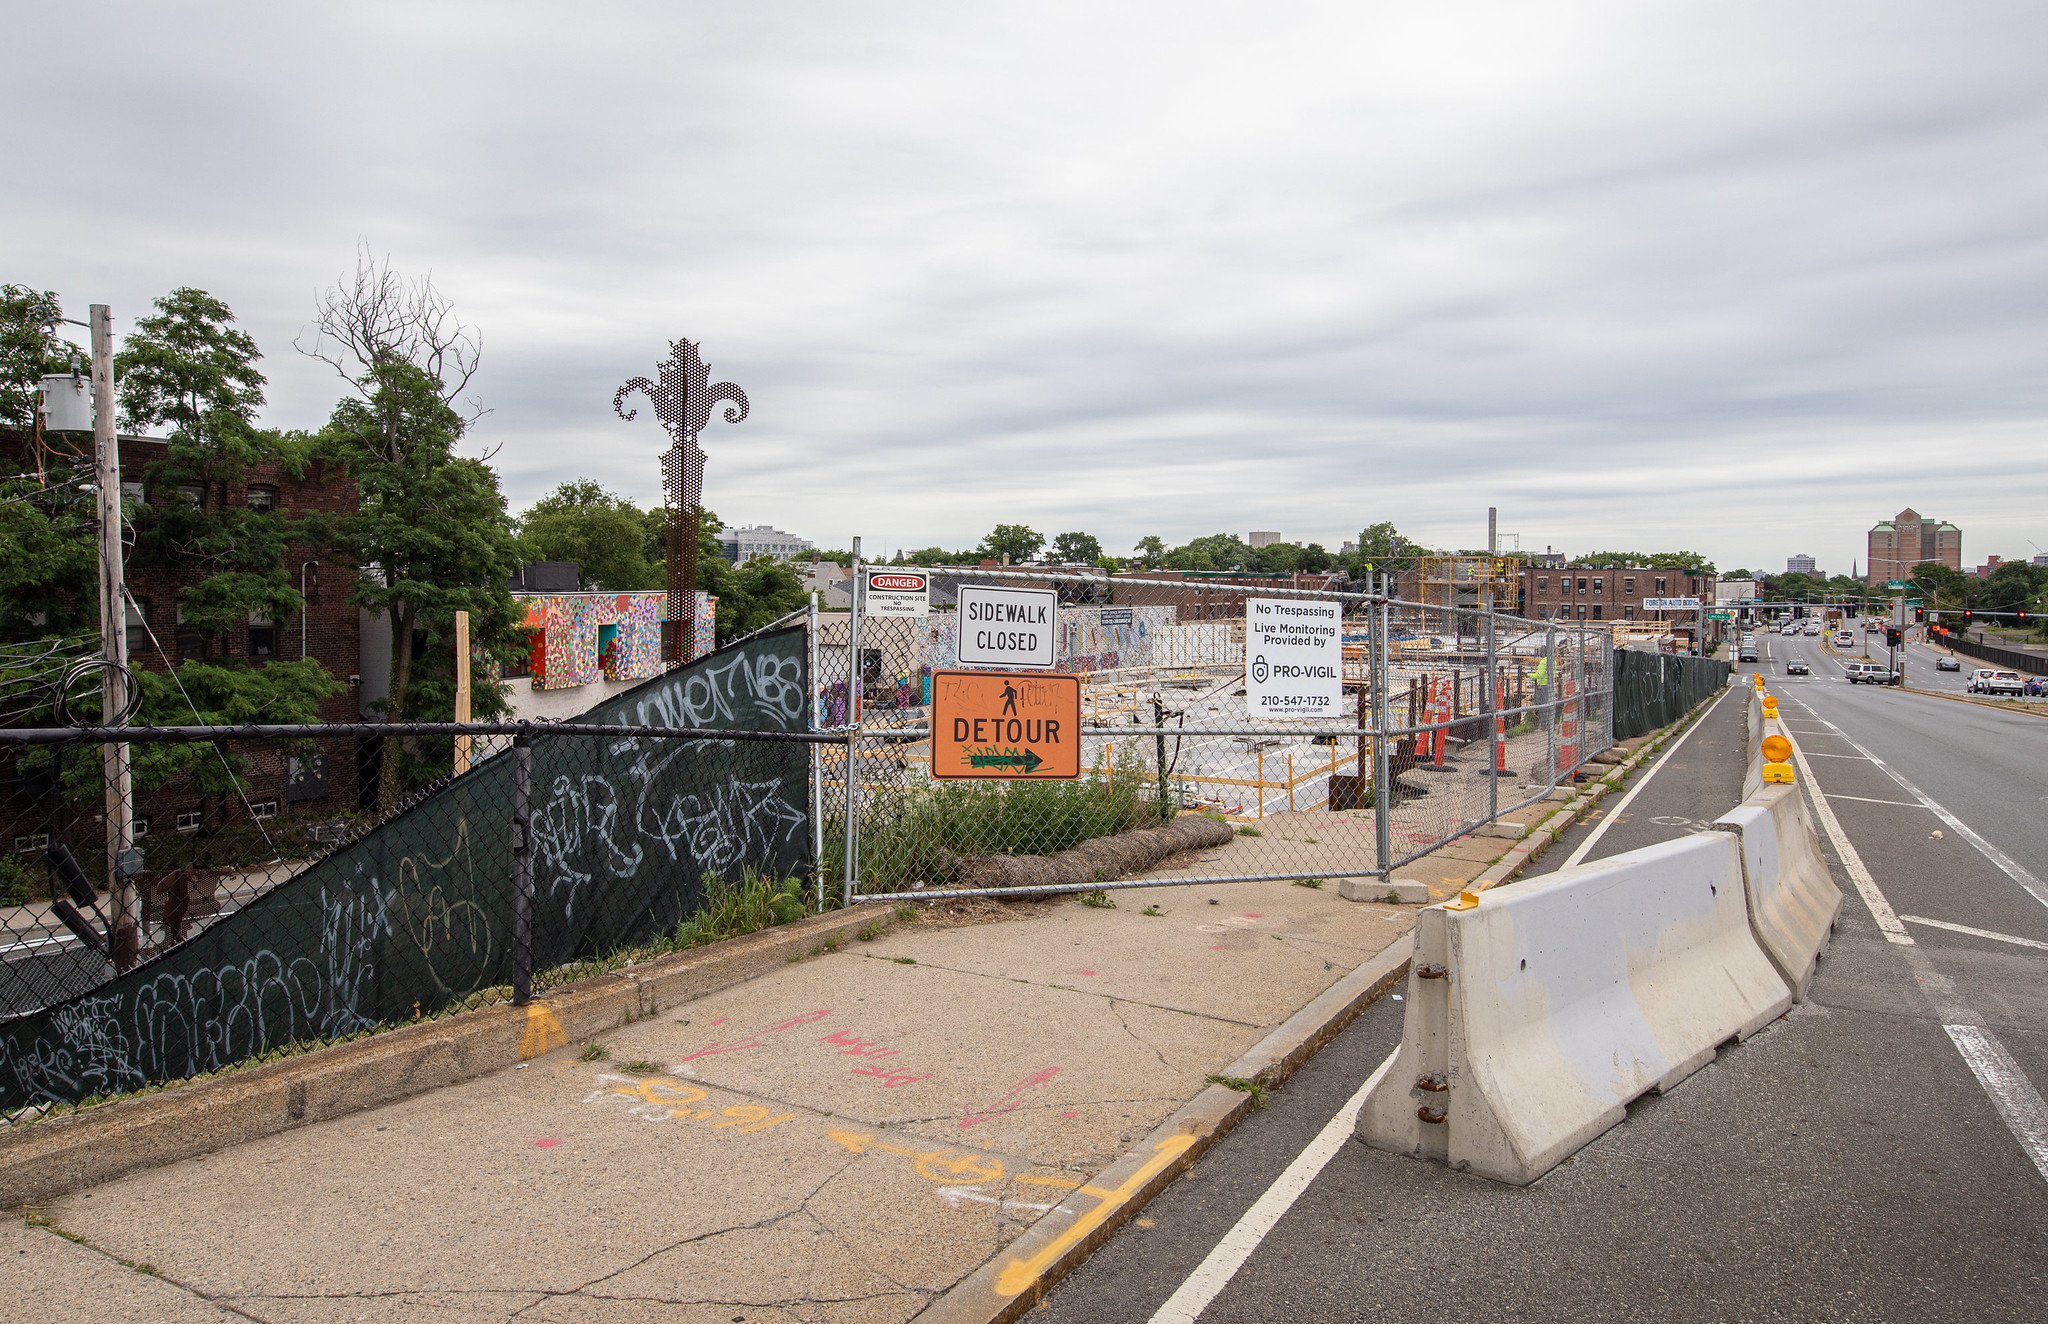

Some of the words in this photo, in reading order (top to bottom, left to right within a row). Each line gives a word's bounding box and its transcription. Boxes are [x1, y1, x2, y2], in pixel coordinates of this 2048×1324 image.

[877, 577, 918, 588] DANGER
[969, 602, 1047, 625] SIDEWALK
[1256, 604, 1271, 615] No
[1274, 604, 1335, 618] Trespassing
[1254, 622, 1276, 633] Live
[1279, 623, 1335, 637] Monitoring
[977, 630, 1038, 652] CLOSED
[1264, 635, 1311, 646] Provided
[1314, 636, 1327, 648] by
[1273, 665, 1337, 679] PRO-VIGIL
[1261, 695, 1330, 706] 210-547-1732
[1268, 706, 1324, 714] www.pro-vigil.com
[954, 717, 1060, 744] DETOUR
